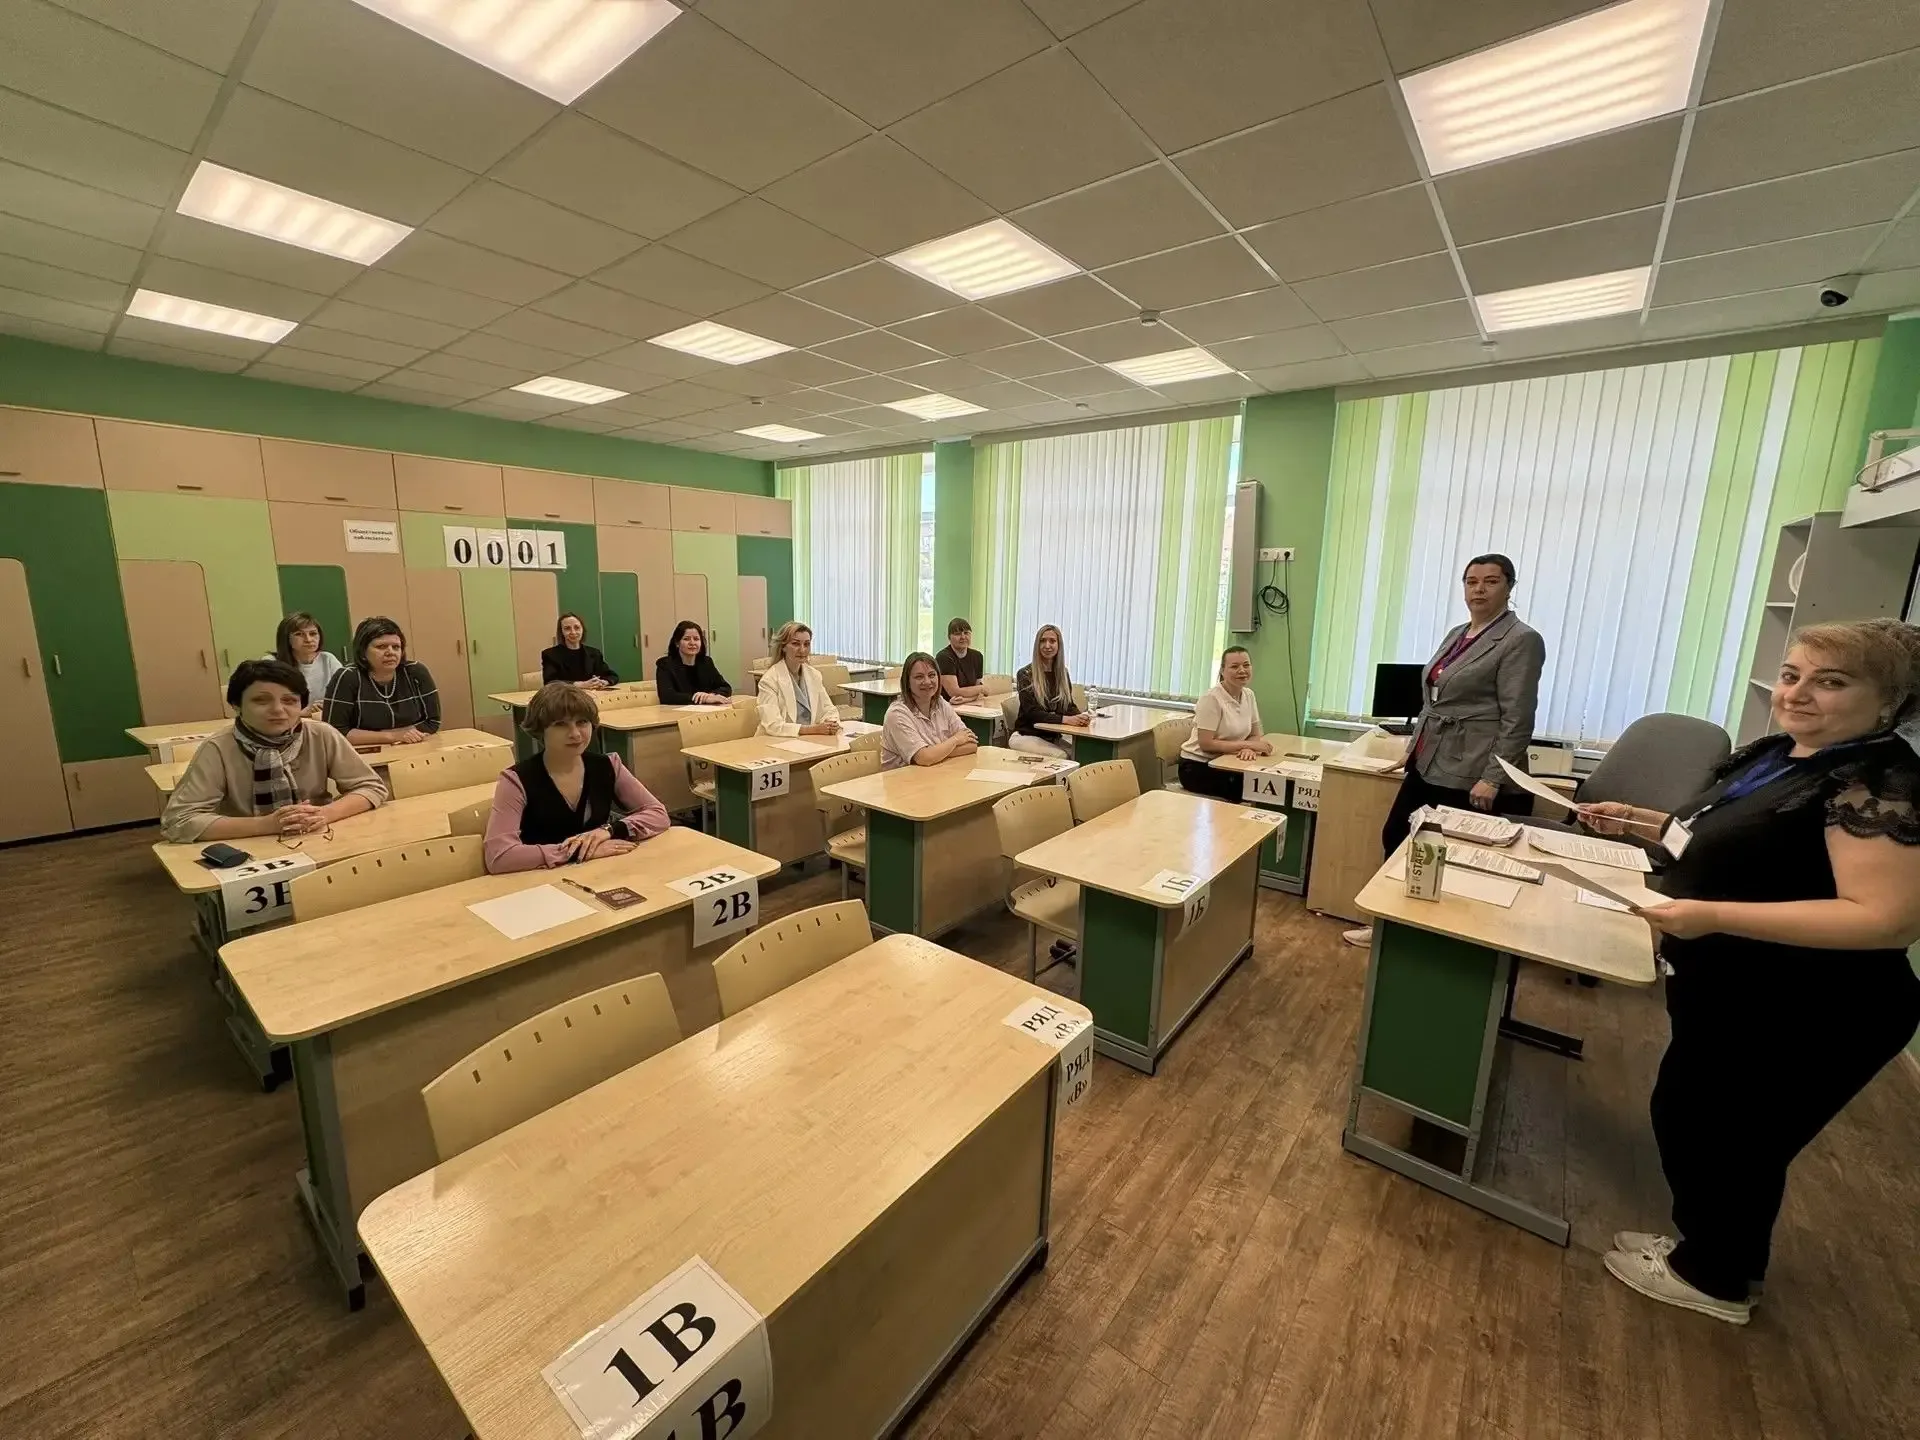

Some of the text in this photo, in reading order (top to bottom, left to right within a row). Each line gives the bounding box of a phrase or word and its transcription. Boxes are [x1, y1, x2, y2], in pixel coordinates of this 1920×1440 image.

[454, 538, 559, 565] 0001
[759, 770, 783, 790] 3Б
[1253, 778, 1278, 796] 1А
[1413, 847, 1425, 876] STAFF
[689, 872, 736, 891] 2В
[711, 891, 752, 927] 2В
[1021, 1005, 1063, 1032] РЯД
[1066, 1046, 1090, 1083] РЯД
[1067, 1079, 1088, 1106] «В»
[603, 1302, 716, 1408] 1В
[666, 1378, 746, 1440] В
